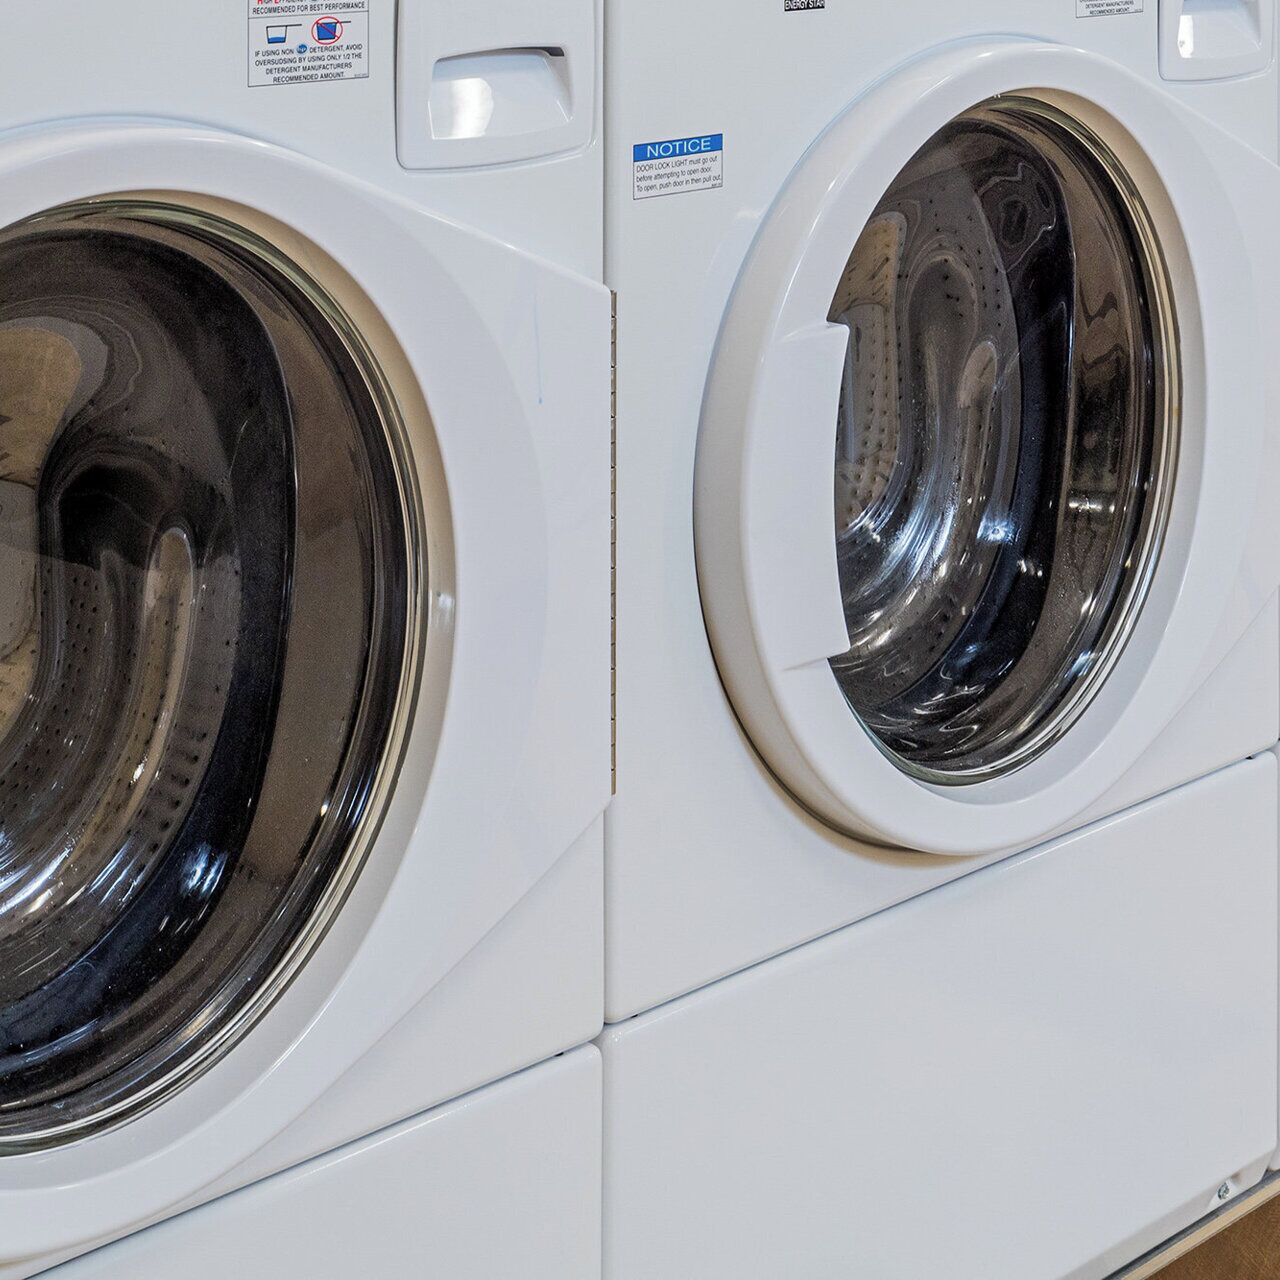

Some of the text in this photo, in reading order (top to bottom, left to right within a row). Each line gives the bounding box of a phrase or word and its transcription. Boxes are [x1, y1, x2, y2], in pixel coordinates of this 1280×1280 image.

[252, 1, 365, 15] RECOMMENDED FOR BEST PERFORMANCE
[261, 48, 280, 57] USING
[281, 47, 294, 56] NON
[345, 43, 362, 51] AVOID
[298, 56, 307, 64] BY
[307, 54, 326, 63] USING
[326, 53, 342, 61] ONLY
[265, 66, 300, 75] DETERGENT
[273, 74, 318, 84] RECOMMENDED
[647, 137, 711, 158] NOTICE
